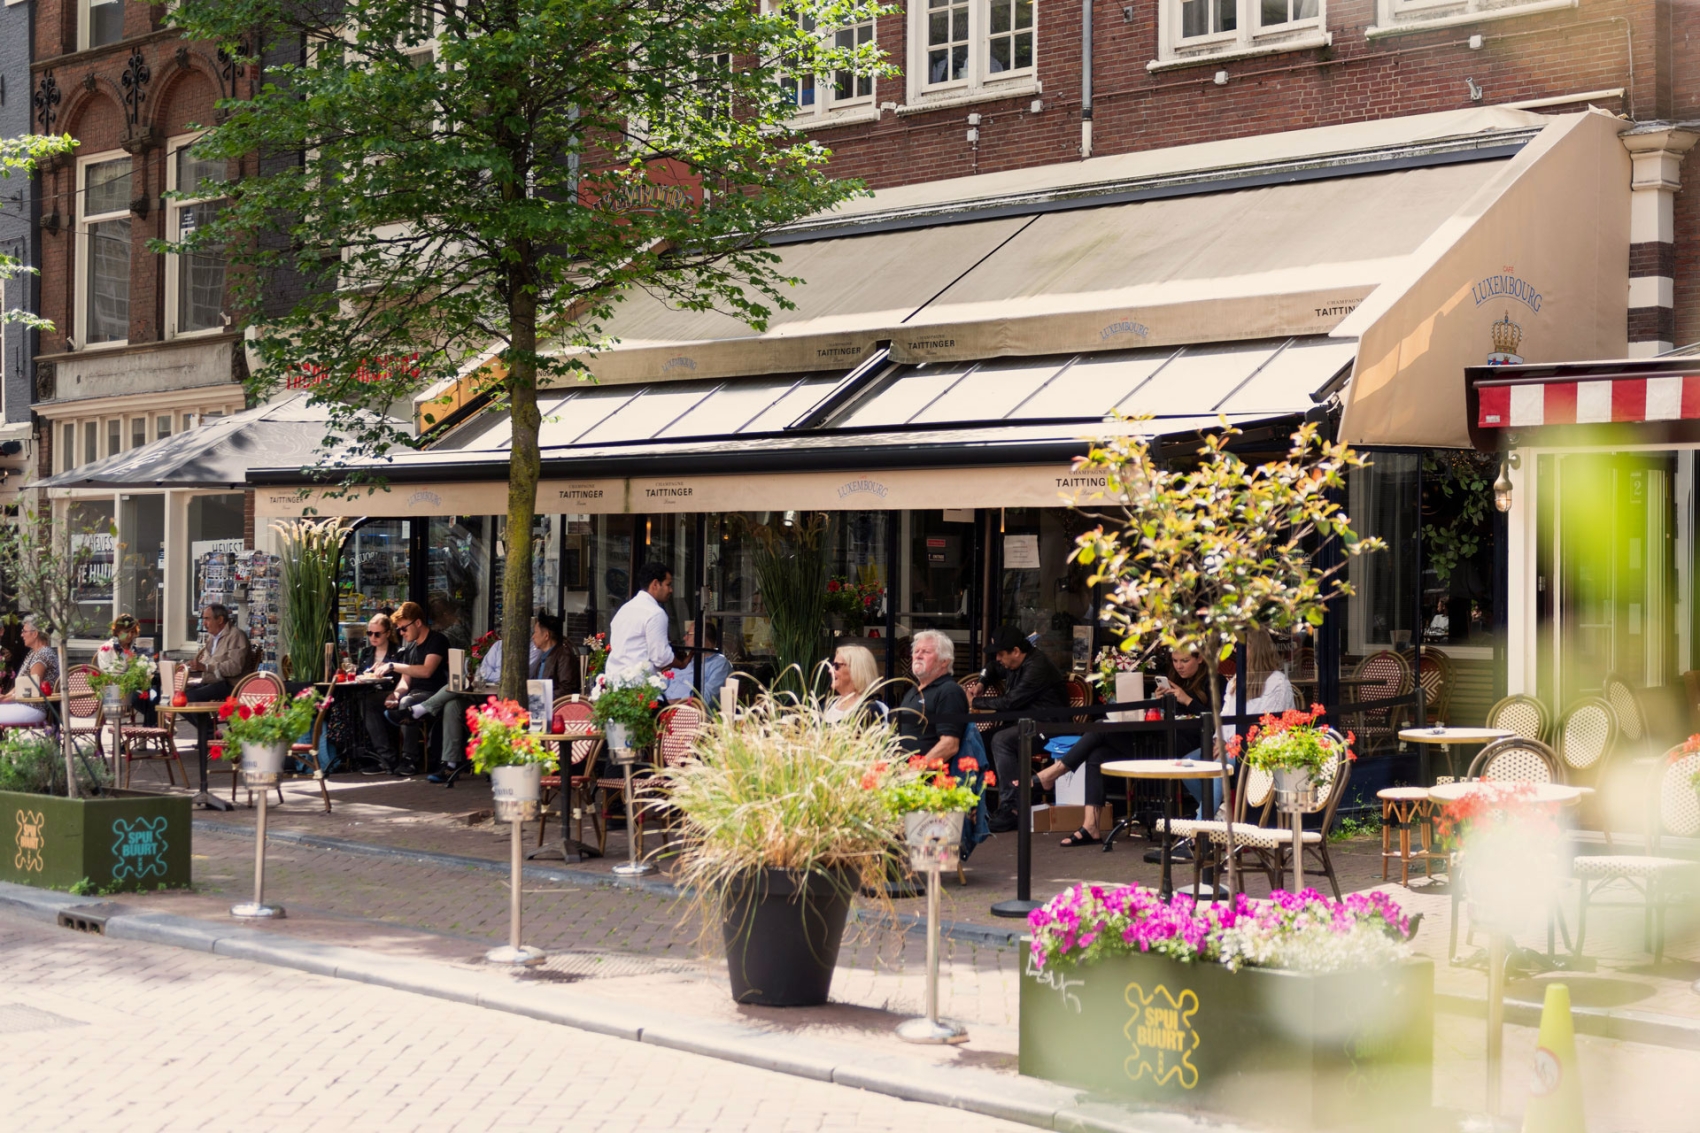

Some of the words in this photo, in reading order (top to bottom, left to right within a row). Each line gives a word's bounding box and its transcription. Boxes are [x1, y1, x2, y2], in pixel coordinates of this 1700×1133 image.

[1472, 275, 1543, 313] LUXEMBOURG
[1314, 305, 1356, 317] TAITTIN
[1099, 321, 1150, 340] LUXEMBOURG
[907, 339, 955, 349] TAITTINGER
[816, 346, 861, 357] TAITTINGER
[837, 480, 889, 499] LUXEMBOURG
[1055, 477, 1110, 488] TAITTING
[559, 490, 604, 499] TAITTINGER
[645, 487, 693, 497] TAITTINGER
[128, 830, 153, 844] SPUI
[122, 842, 158, 857] BUURT
[1145, 1006, 1178, 1031] SPUI
[1137, 1024, 1186, 1052] BUURT
